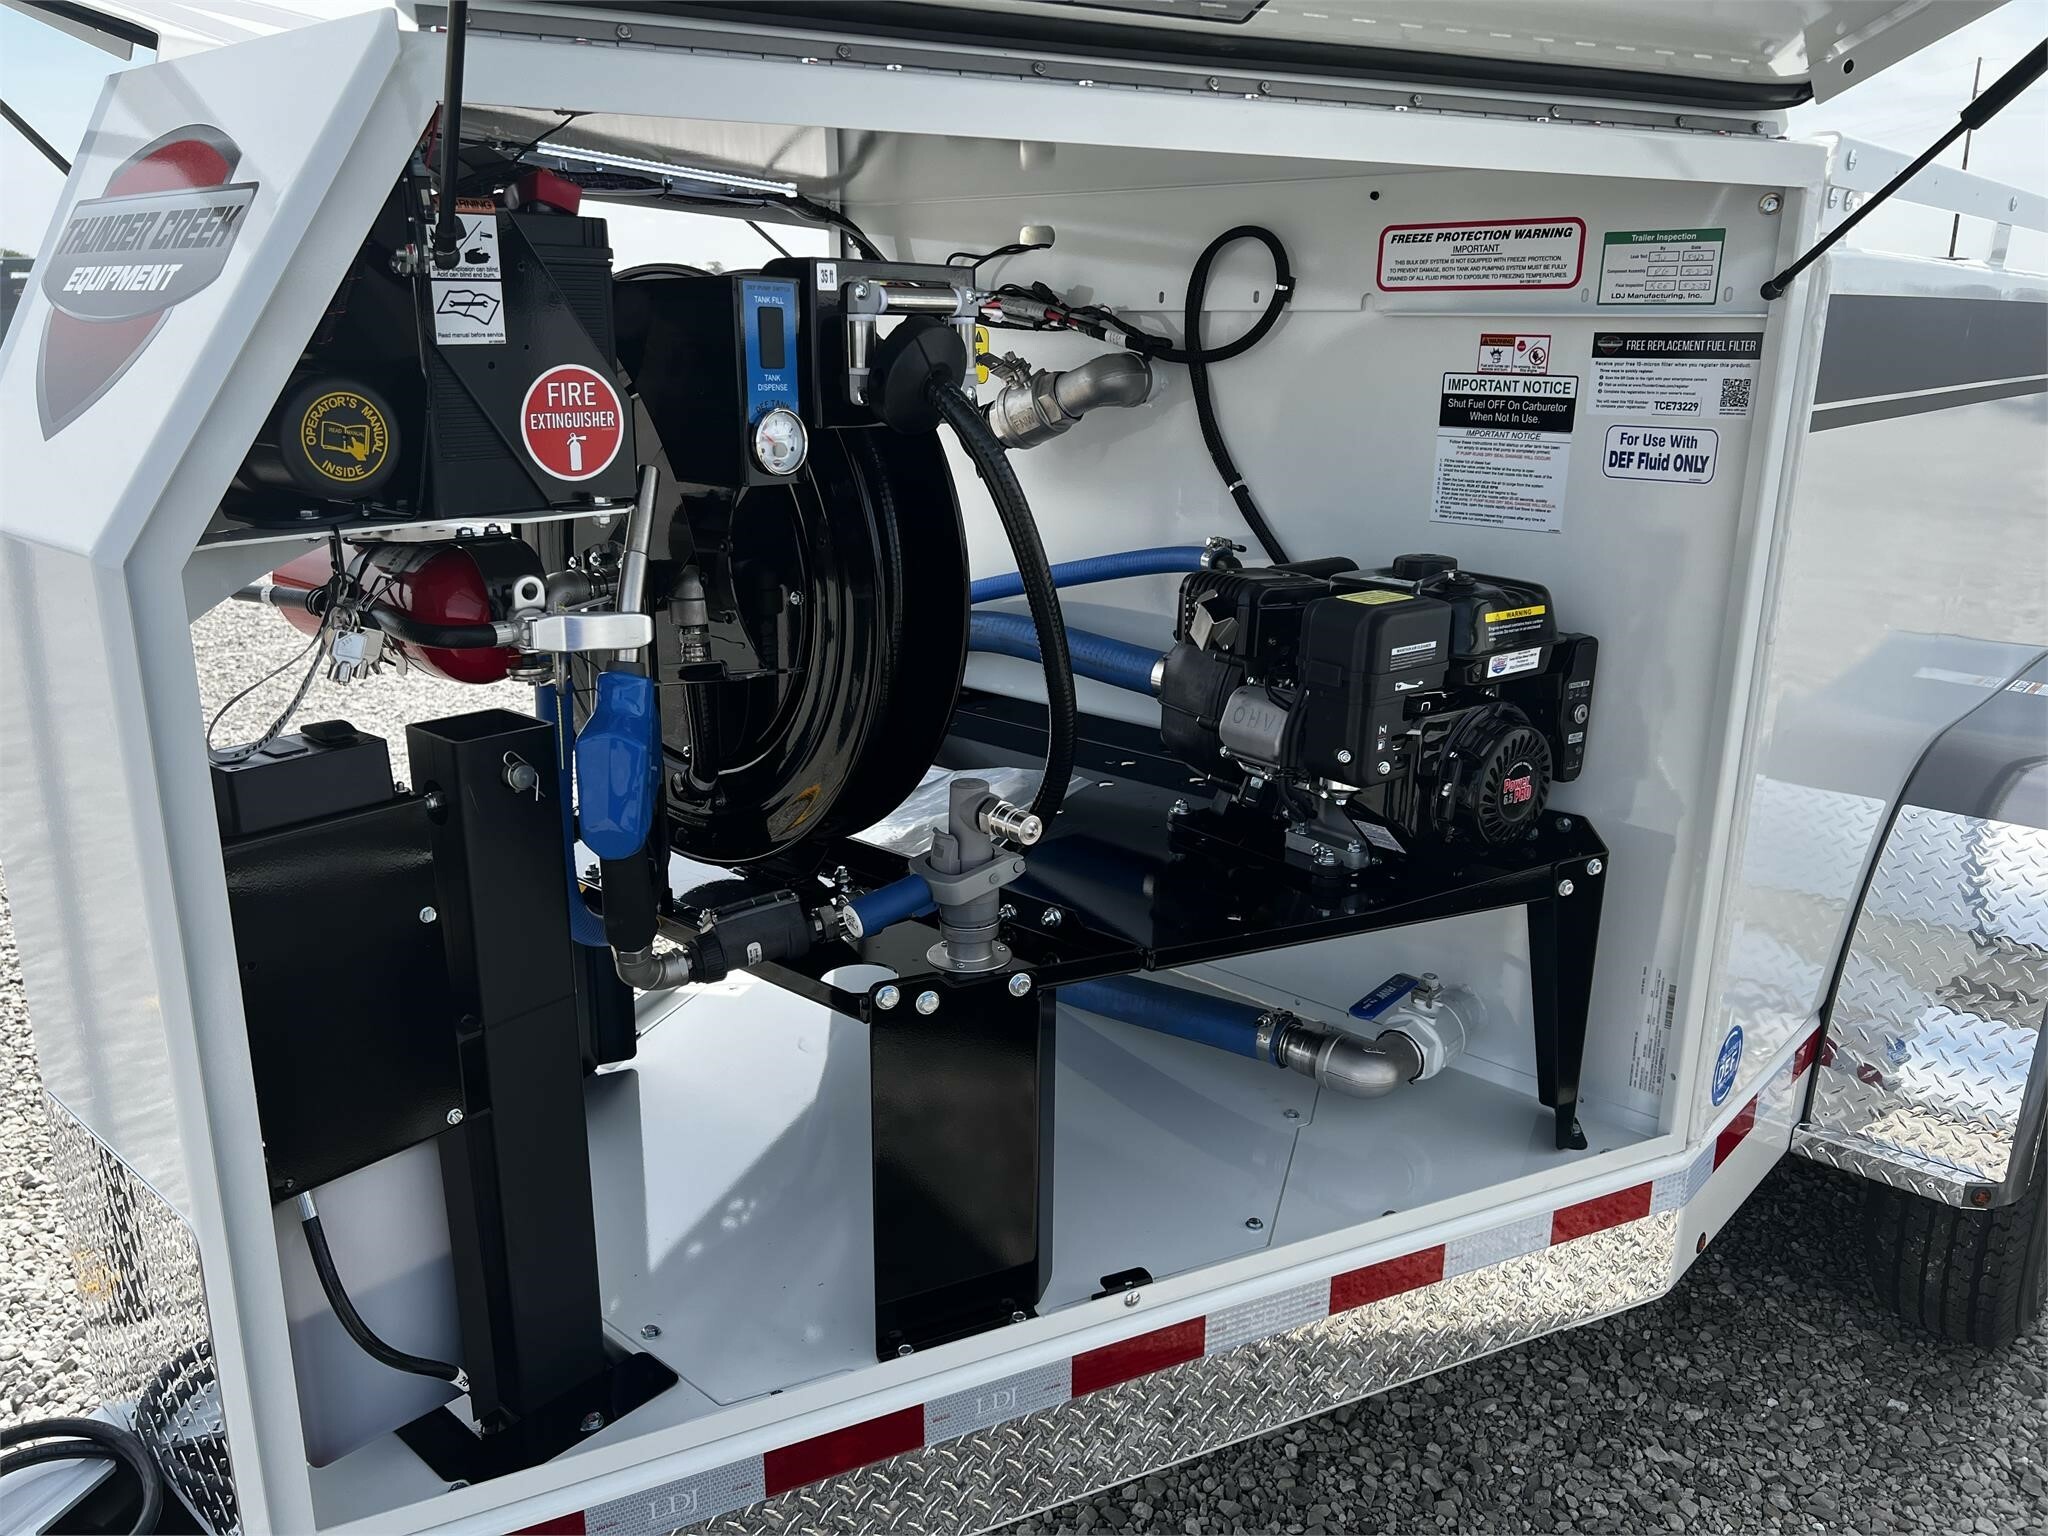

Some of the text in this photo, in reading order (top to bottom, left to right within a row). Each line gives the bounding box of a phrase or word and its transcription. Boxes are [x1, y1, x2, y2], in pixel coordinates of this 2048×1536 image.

[456, 200, 492, 210] RNING
[57, 205, 244, 255] THUNDER CREEK
[1390, 227, 1573, 243] FREEZE PROTECTION WARNING
[1631, 232, 1697, 242] Trailer Inspection
[1452, 244, 1499, 252] IMPORTANT
[63, 264, 183, 294] EQUIPMENT
[820, 269, 834, 283] 35 ft
[754, 295, 784, 304] TANK FILL
[1625, 339, 1646, 350] FREE
[1646, 340, 1706, 351] REPLACEMENT
[1706, 340, 1727, 351] FUEL
[1728, 340, 1756, 352] FILTER
[547, 382, 597, 406] FIRE
[1447, 378, 1571, 394] IMPORTANT NOTICE
[756, 400, 769, 413] DEF
[1447, 398, 1567, 412] Shut Fuel OFF On Carburetor
[1653, 400, 1698, 411] TCE73229
[306, 397, 384, 453] OPERATOR'S MANUAL
[530, 411, 615, 429] EXTINGUISHER
[1468, 411, 1541, 424] When Not In Use.
[1465, 429, 1541, 440] IMPORTANT NOTICE
[1619, 432, 1698, 449] For Use With
[322, 460, 365, 477] INSIDE
[1608, 450, 1709, 473] DEF Fluid ONLY
[1506, 609, 1532, 618] WARNING
[1233, 706, 1276, 729] OHV
[1503, 785, 1532, 805] 6.5 PRO
[1717, 1050, 1738, 1084] DEF
[976, 1387, 1019, 1414] LDJ
[648, 1487, 702, 1519] LDJ
